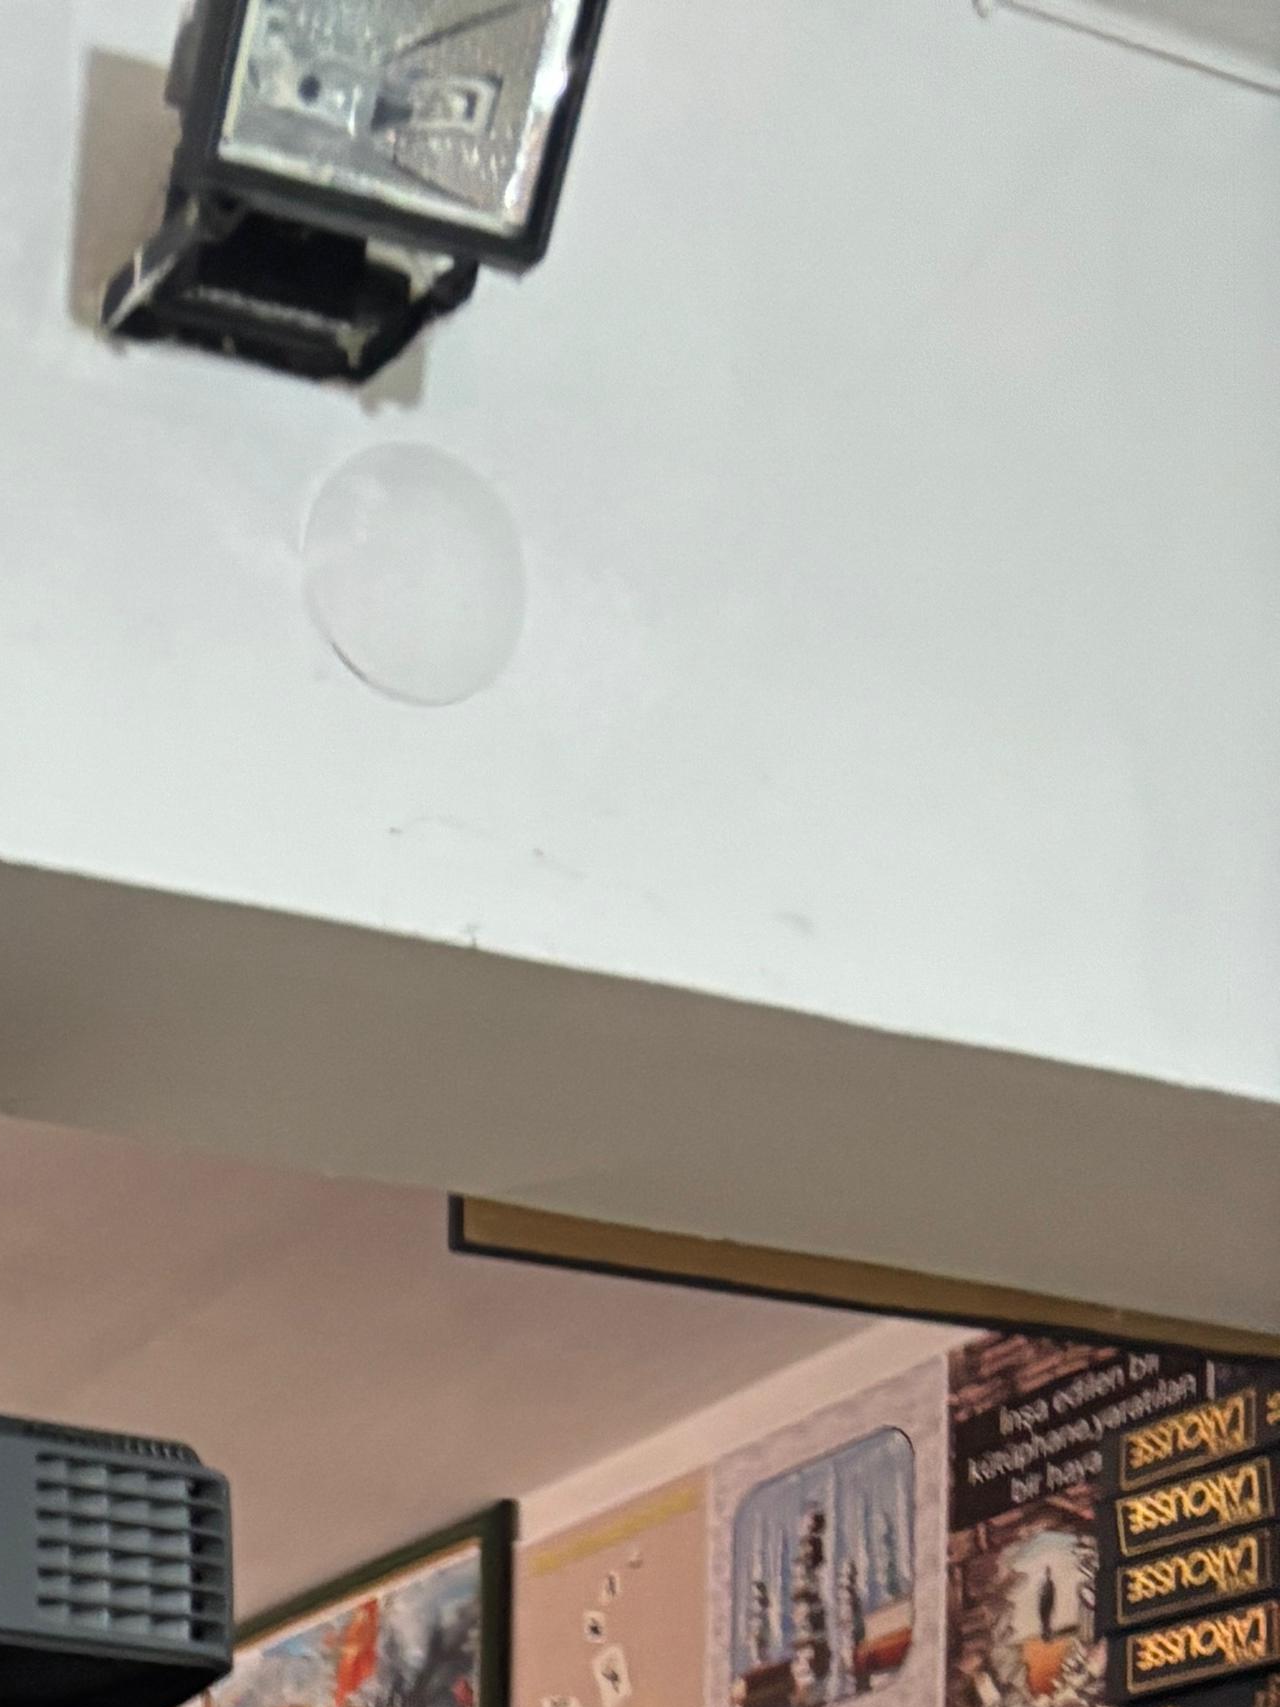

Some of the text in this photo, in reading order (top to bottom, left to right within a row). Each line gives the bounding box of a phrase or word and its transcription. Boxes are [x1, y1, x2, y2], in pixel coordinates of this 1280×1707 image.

[1129, 1395, 1245, 1470] LAROUSSE
[1046, 1450, 1103, 1490] haya
[1127, 1464, 1261, 1535] LAROUSSE
[1126, 1535, 1259, 1604] LAROUSSE
[1136, 1604, 1268, 1672] LAROUSSE
